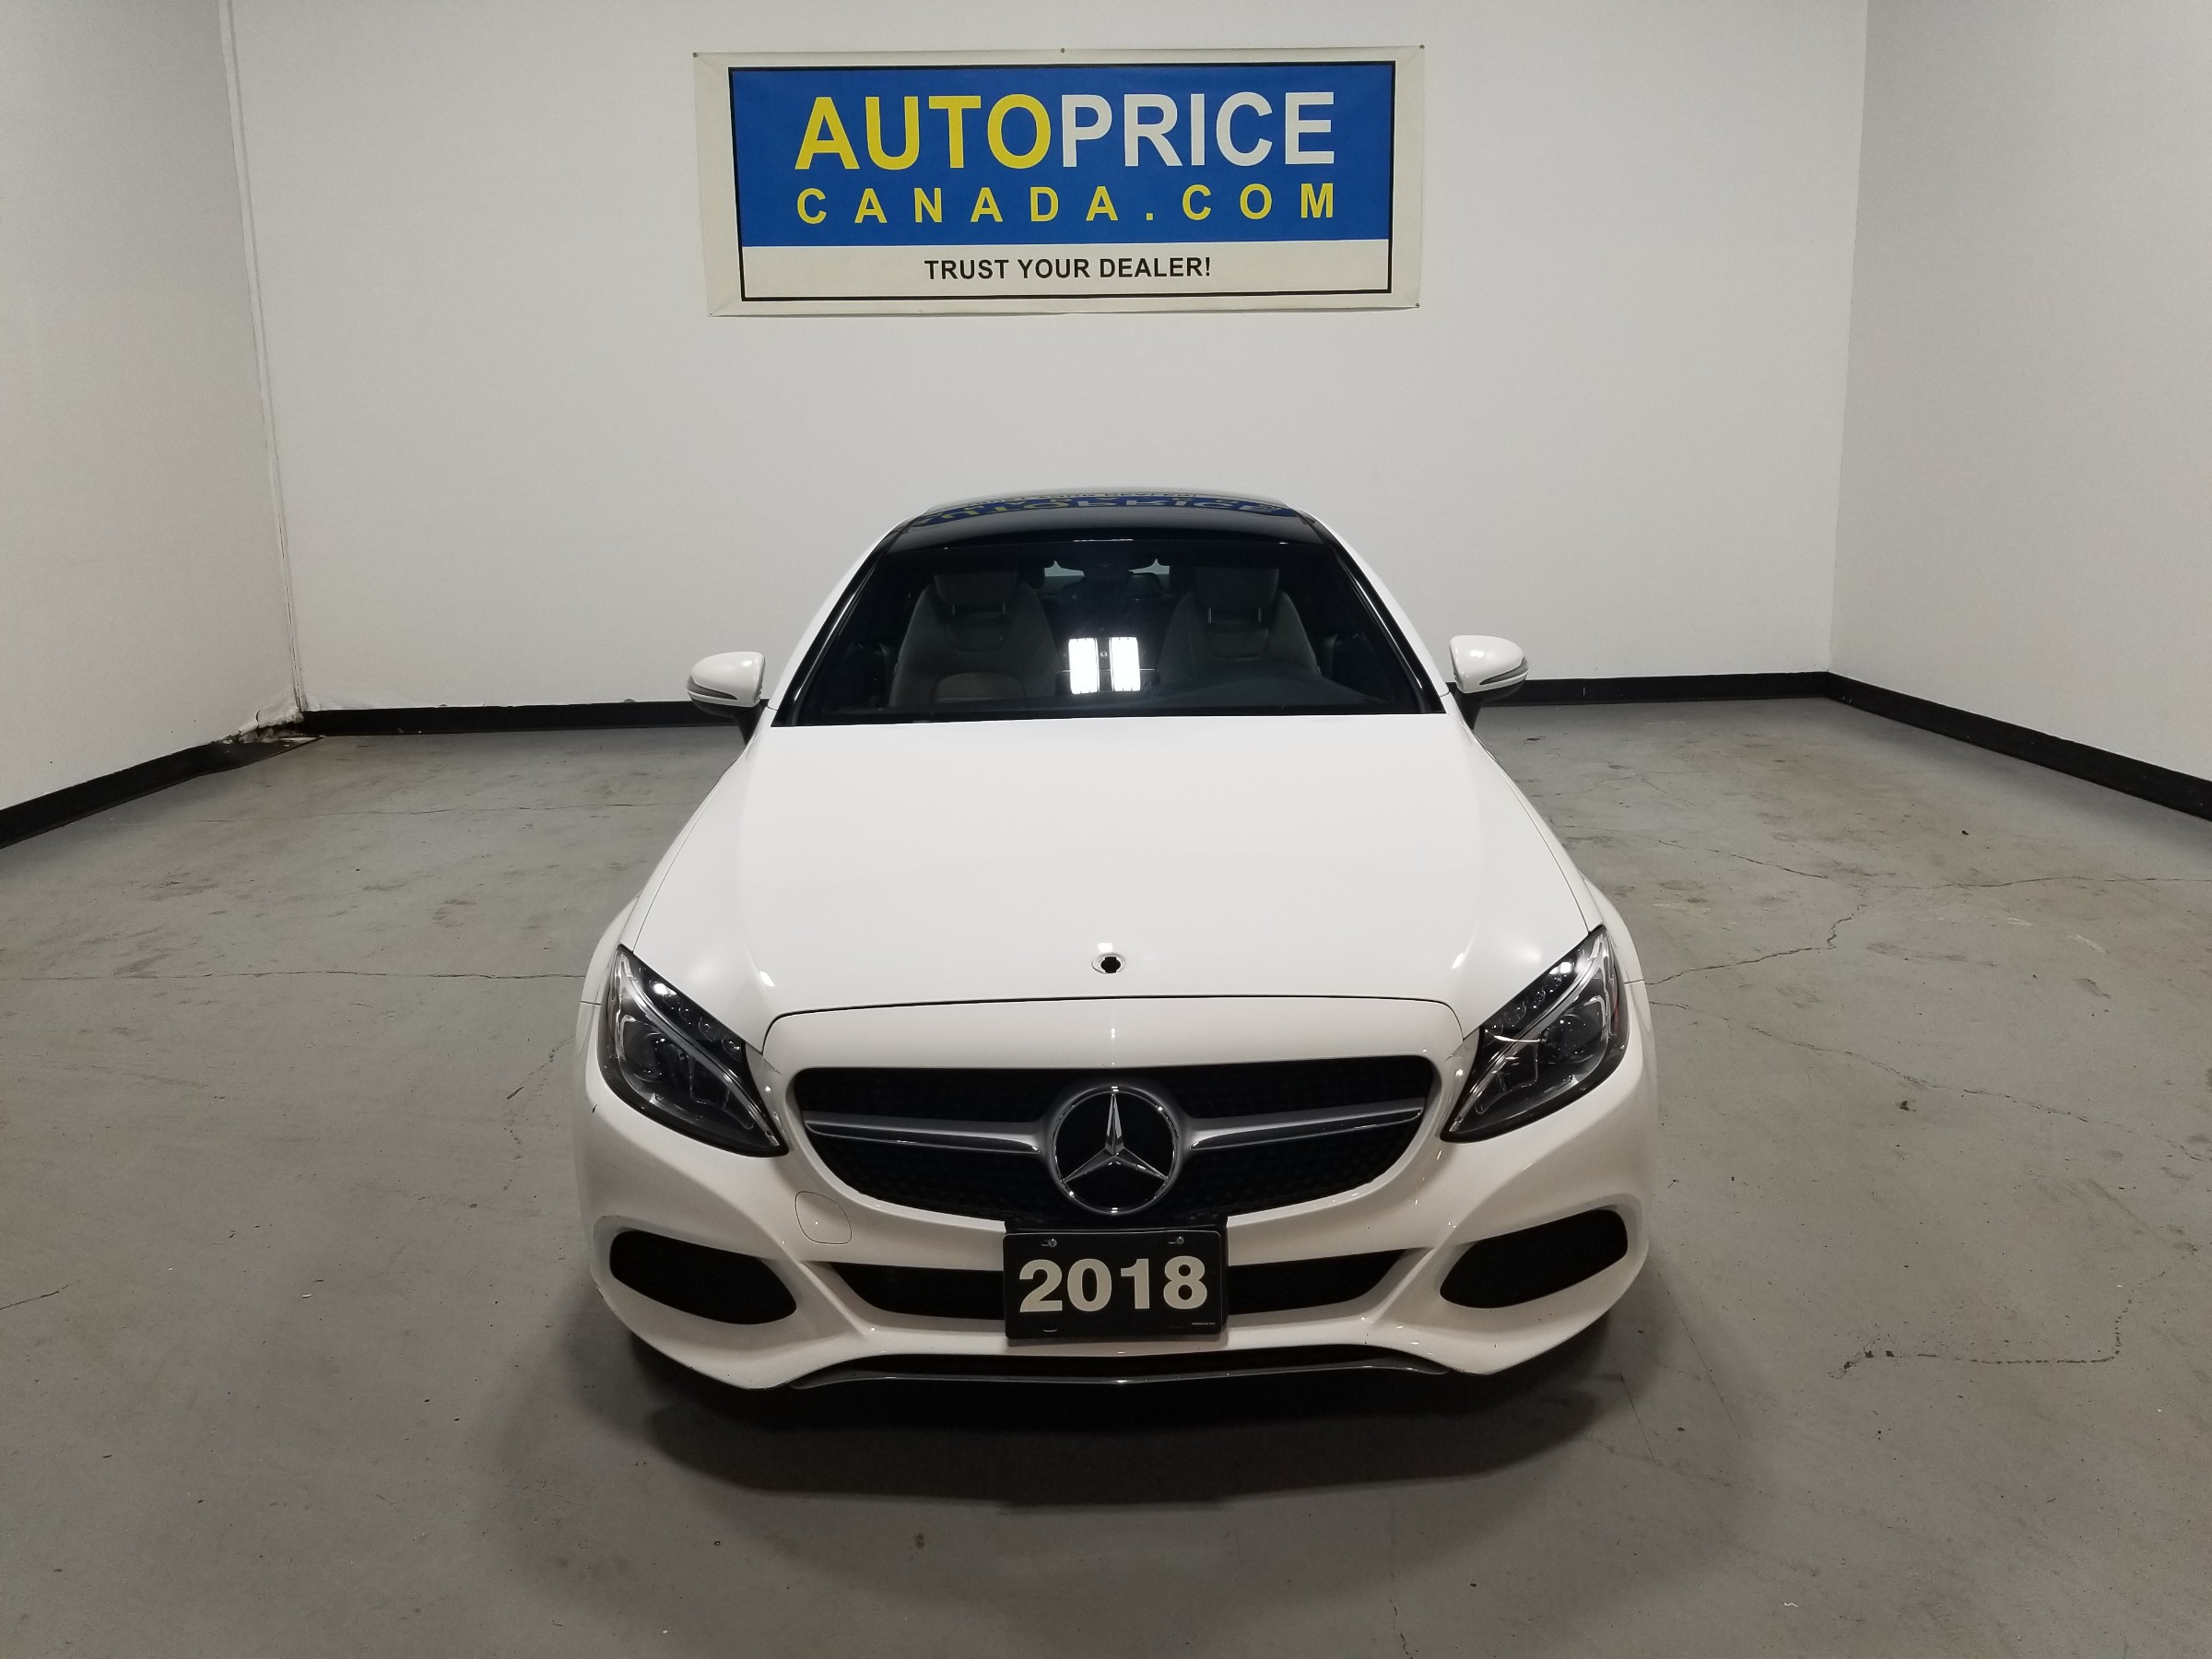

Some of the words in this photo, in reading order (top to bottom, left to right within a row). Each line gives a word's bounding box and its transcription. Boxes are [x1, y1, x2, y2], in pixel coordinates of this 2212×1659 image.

[794, 91, 1335, 171] AUTOPRICE
[924, 259, 1010, 280] TRUST
[1017, 258, 1091, 279] YOUR
[1100, 256, 1210, 278] DEALER!
[1018, 1255, 1208, 1313] 2018
